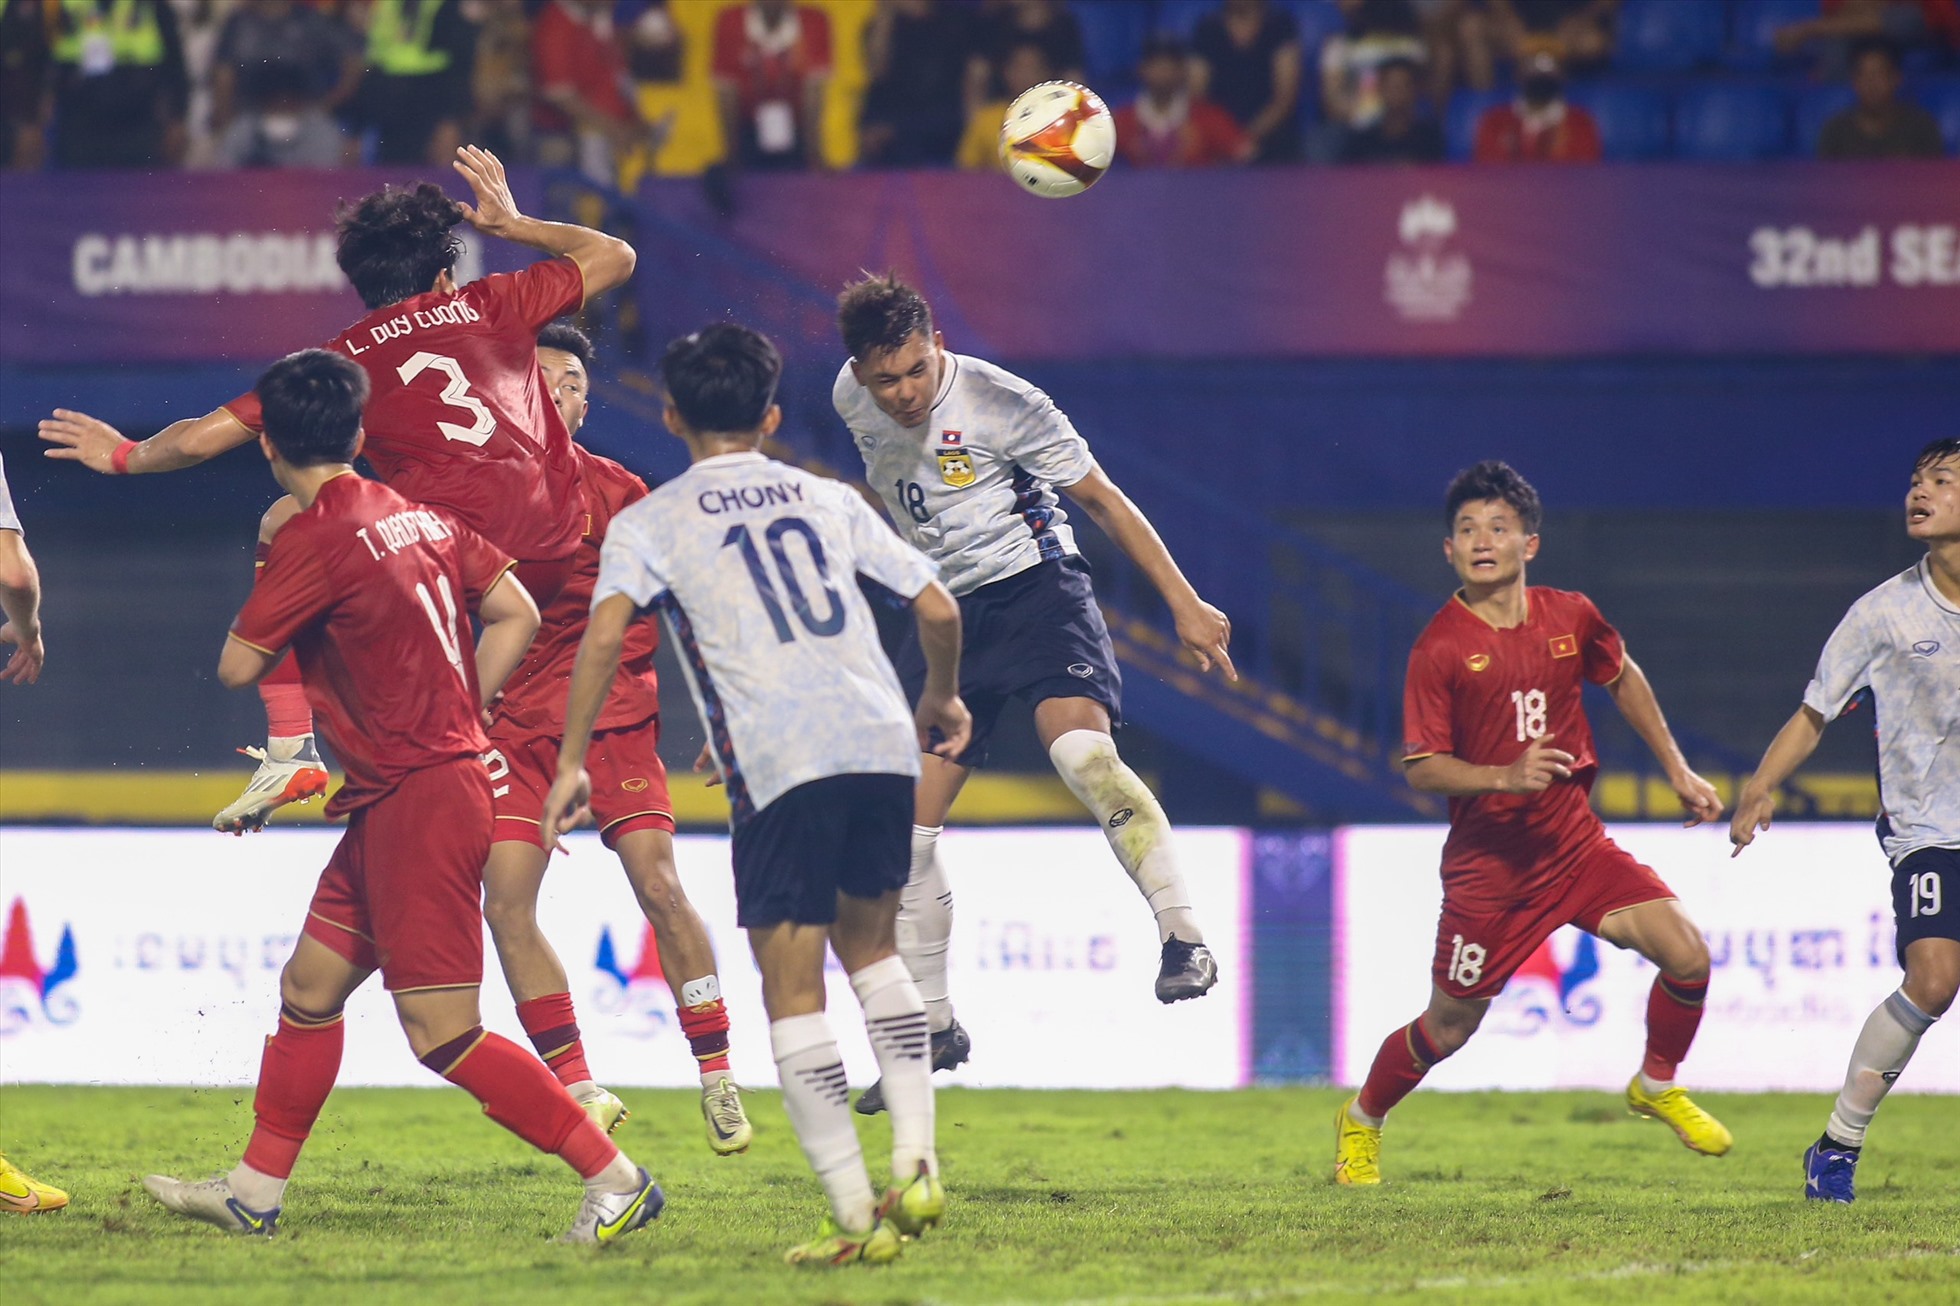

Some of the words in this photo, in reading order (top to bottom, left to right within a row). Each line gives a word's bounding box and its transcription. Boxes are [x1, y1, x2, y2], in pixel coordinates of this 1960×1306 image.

[73, 235, 344, 294] CAMBODIA
[1750, 226, 1879, 287] 32nd
[1891, 225, 1960, 288] SE
[346, 338, 370, 356] L.
[370, 315, 413, 345] DUY
[414, 300, 480, 329] CUONG
[396, 351, 497, 447] 3
[698, 483, 804, 515] CHONY
[895, 478, 932, 524] 18
[720, 516, 845, 644] 10
[1511, 688, 1547, 742] 18
[1909, 871, 1942, 919] 19
[1448, 934, 1487, 987] 18
